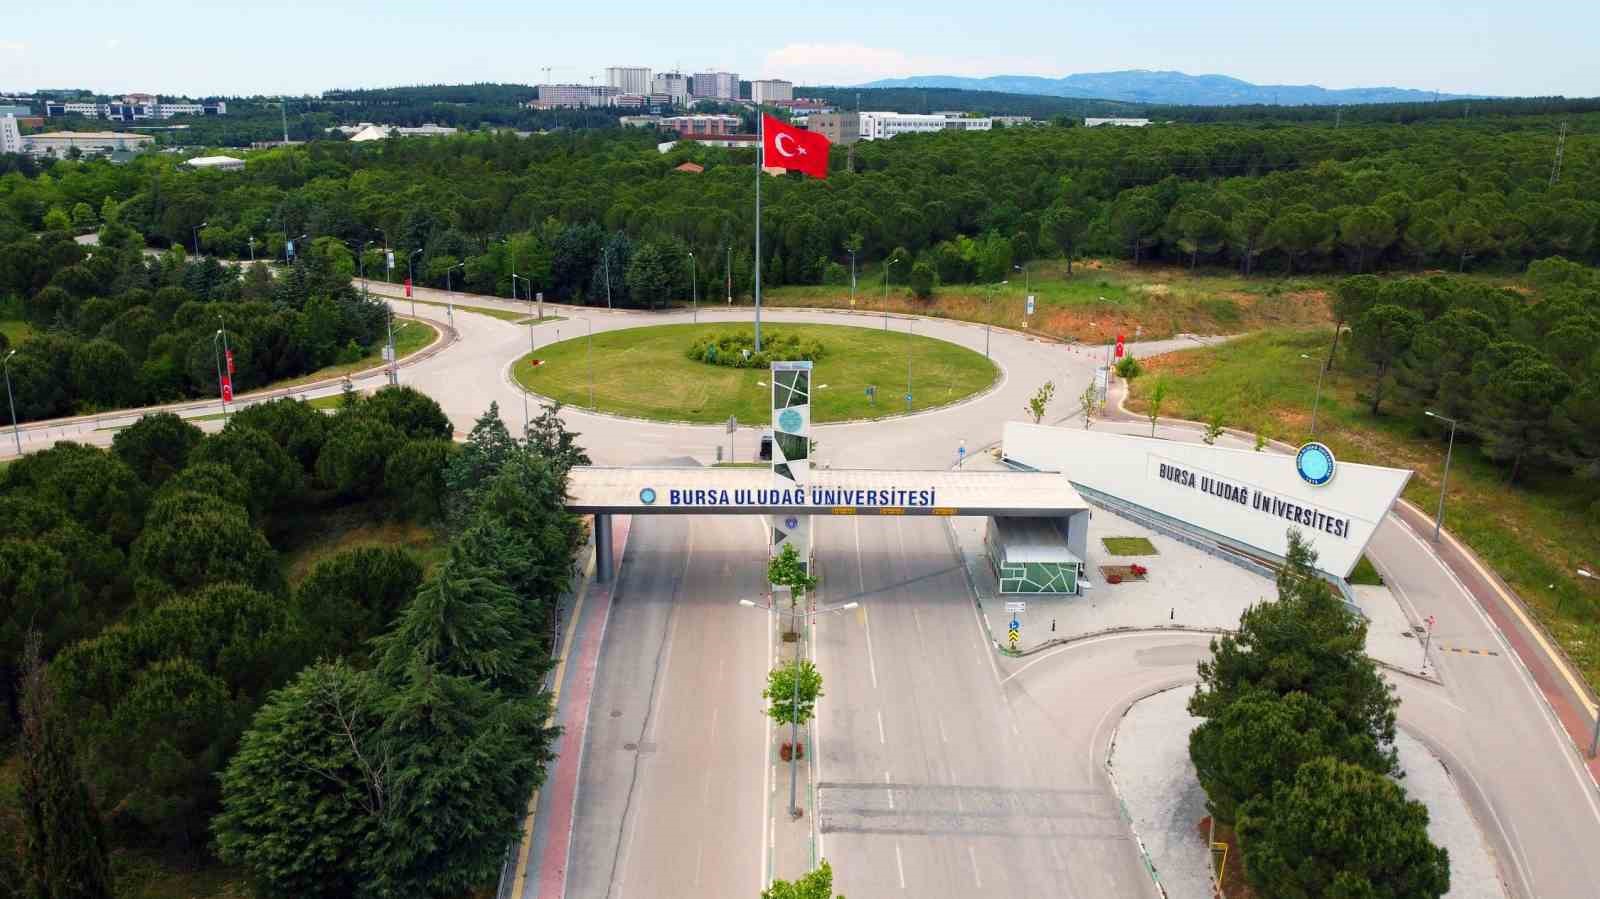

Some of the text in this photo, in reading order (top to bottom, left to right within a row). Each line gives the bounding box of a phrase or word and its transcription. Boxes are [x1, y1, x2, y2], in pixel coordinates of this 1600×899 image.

[670, 485, 936, 506] BURSA ULUDAĞ ÜNİVERSİTESİ
[1159, 463, 1351, 539] BURSA ULUDAĞ ÜNİVERSİTESİ
